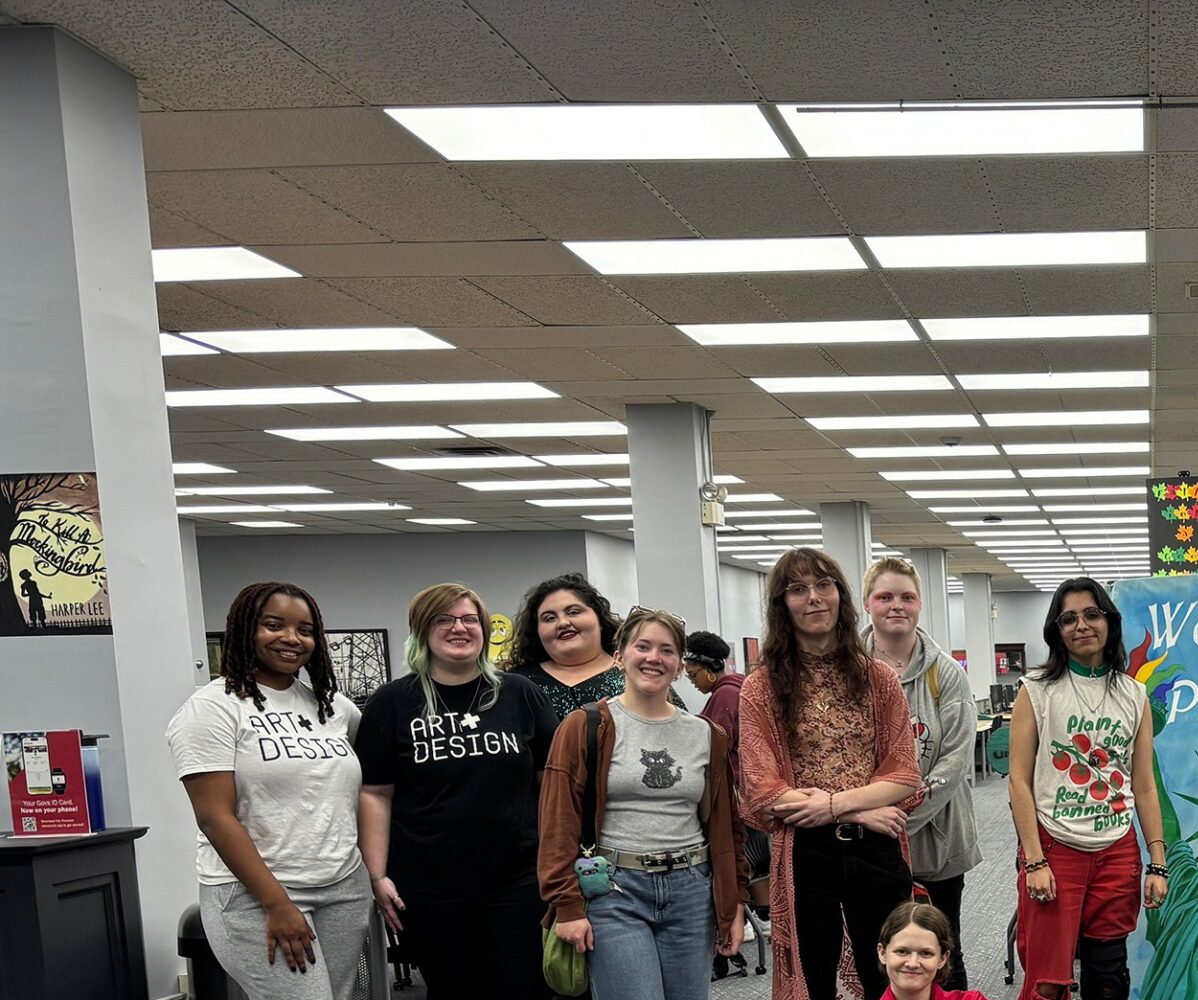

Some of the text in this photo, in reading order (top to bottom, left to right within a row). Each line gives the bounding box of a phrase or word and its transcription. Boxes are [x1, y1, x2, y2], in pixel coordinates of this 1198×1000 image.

[51, 518, 80, 540] Kill
[18, 521, 102, 575] Mockingbird
[51, 601, 105, 617] HARPER LEE
[1066, 714, 1122, 736] Plant
[413, 731, 520, 764] DESIGN
[1100, 733, 1133, 750] good
[1055, 785, 1089, 805] Read
[57, 806, 78, 814] phone!
[1052, 803, 1110, 820] banned
[1093, 812, 1131, 832] books
